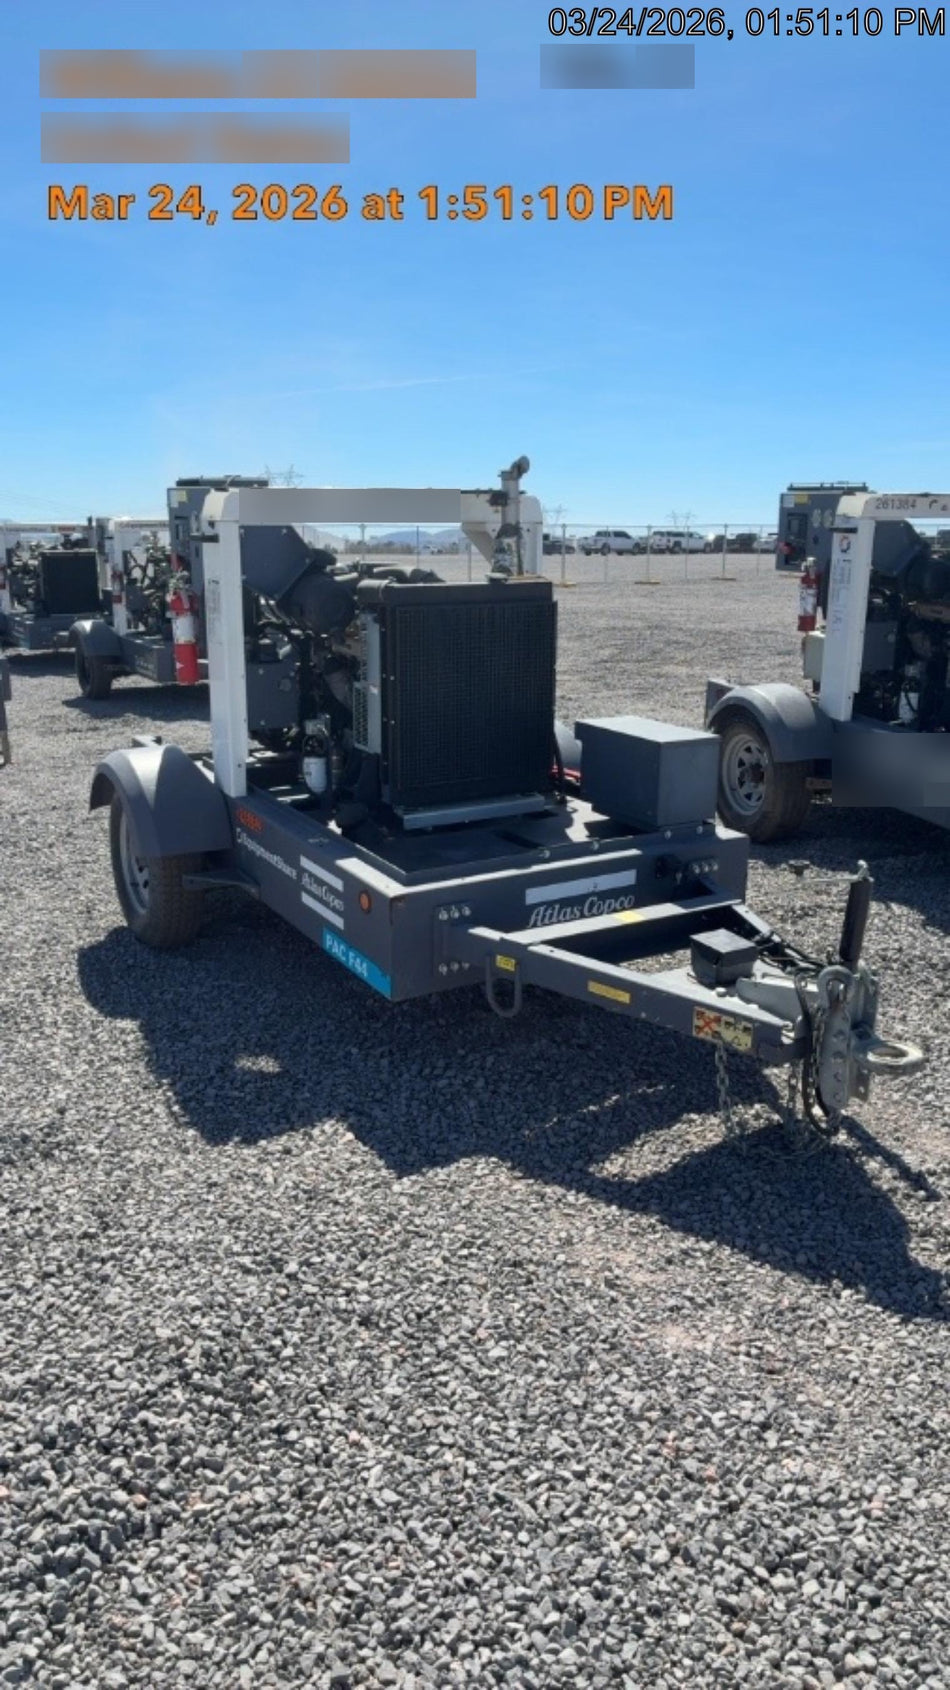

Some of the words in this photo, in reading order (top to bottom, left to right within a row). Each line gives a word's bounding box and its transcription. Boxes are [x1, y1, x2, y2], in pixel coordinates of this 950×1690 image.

[875, 499, 917, 511] 261384
[526, 903, 582, 929] Atlas
[583, 895, 636, 918] Copco
[326, 934, 347, 961] PAC
[348, 951, 369, 978] F44
